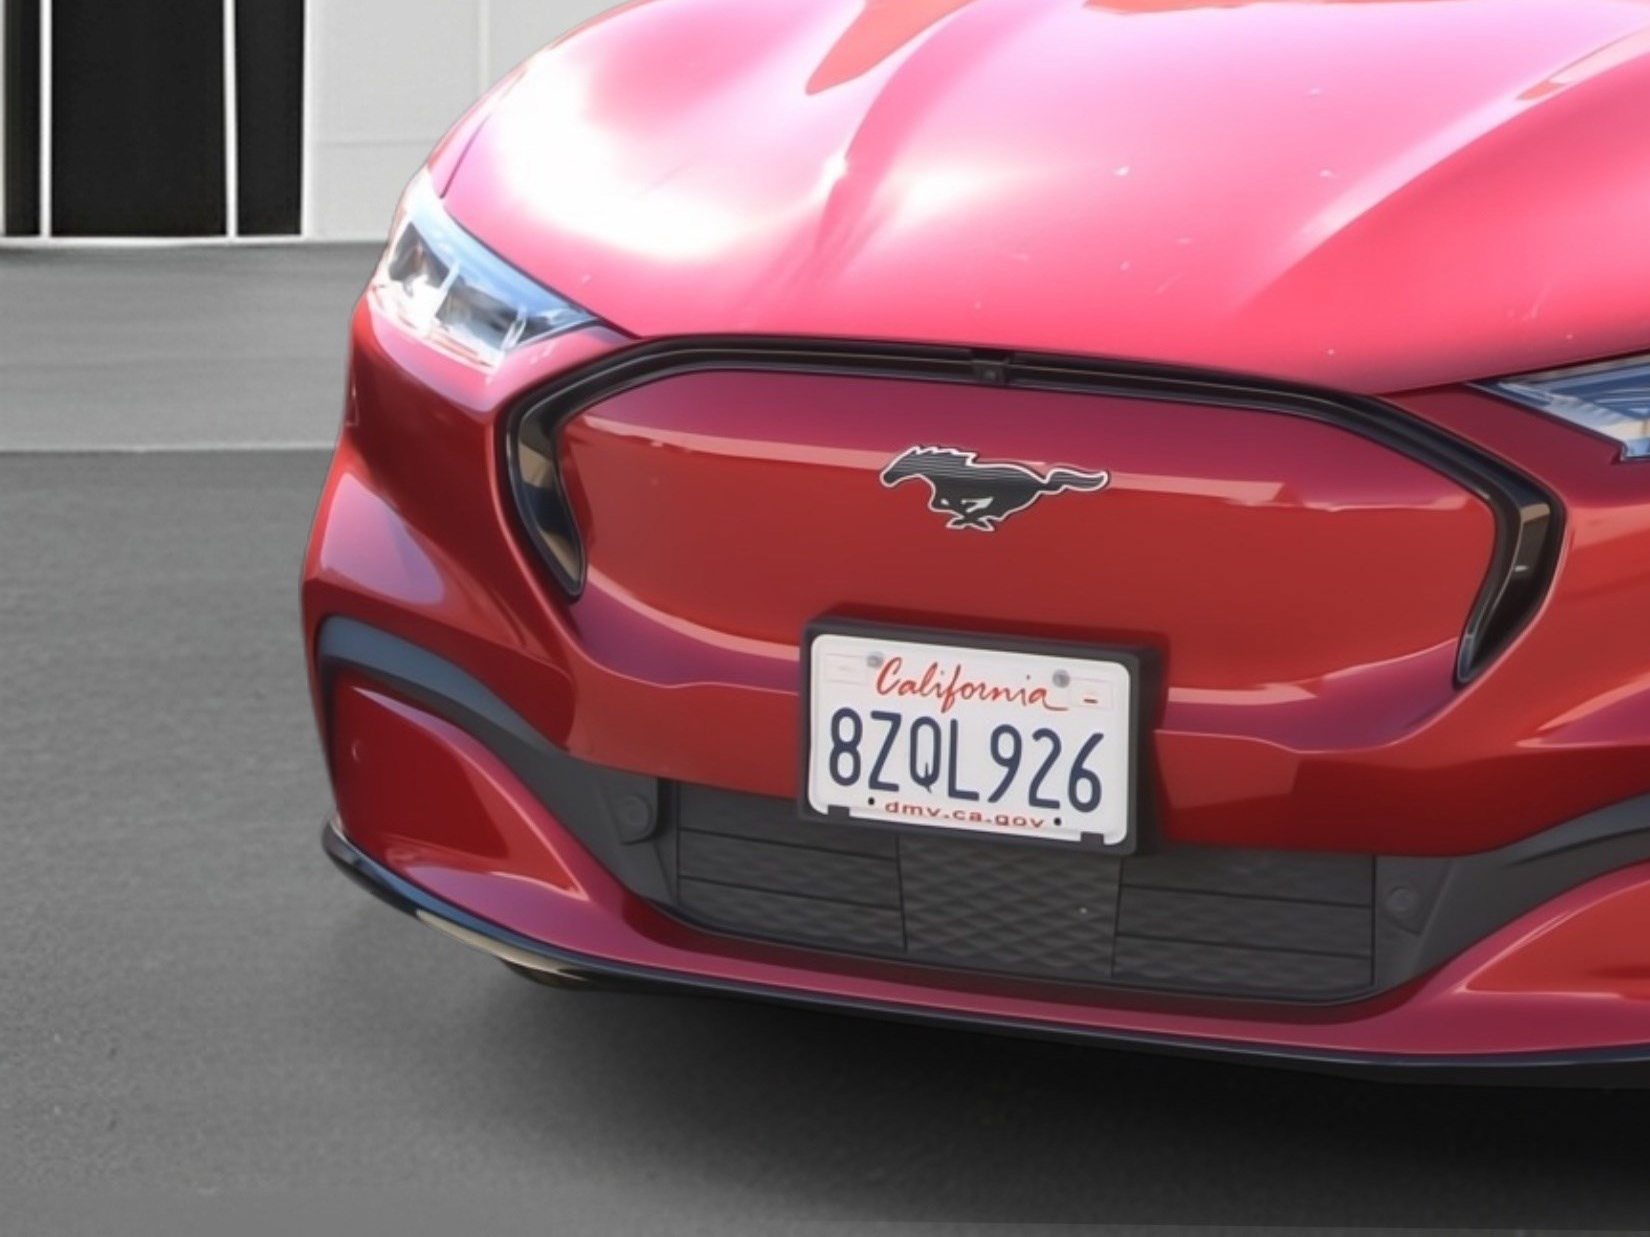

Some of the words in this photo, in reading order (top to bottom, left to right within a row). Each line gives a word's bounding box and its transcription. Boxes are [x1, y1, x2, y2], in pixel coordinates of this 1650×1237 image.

[875, 657, 1068, 713] California
[829, 707, 1104, 813] 8ZQL926
[884, 799, 1045, 829] dmv.ca.gov
